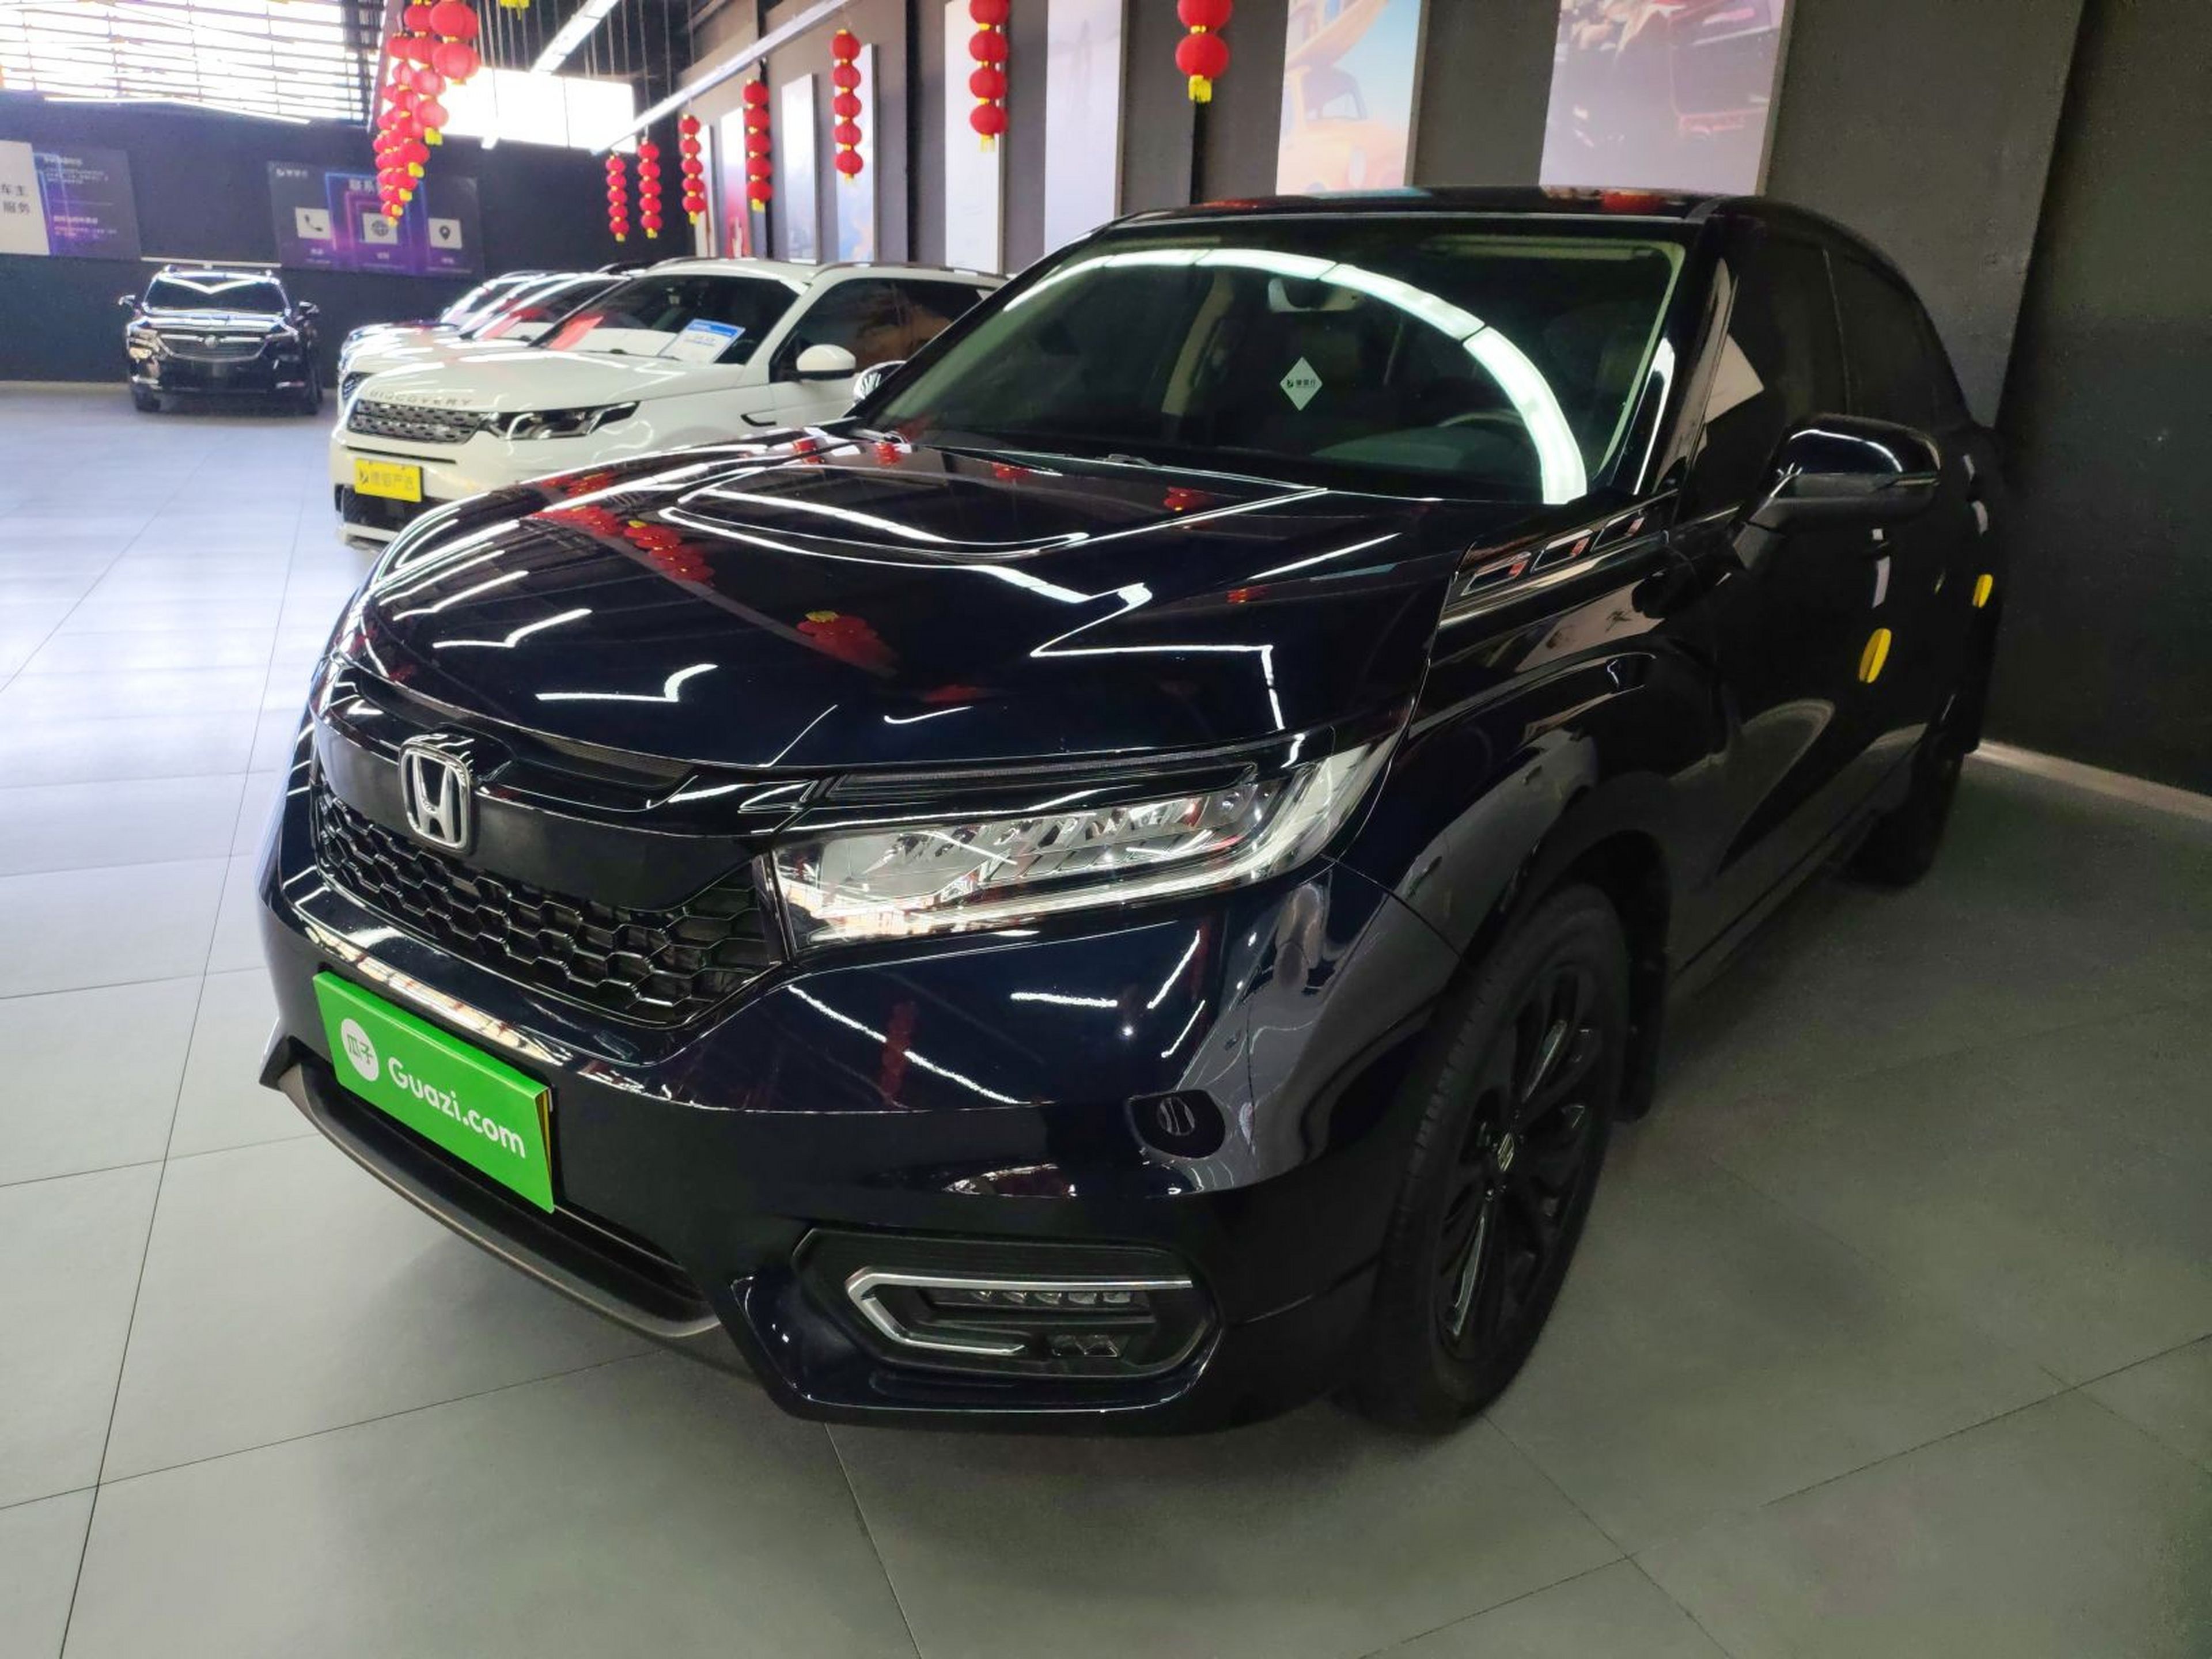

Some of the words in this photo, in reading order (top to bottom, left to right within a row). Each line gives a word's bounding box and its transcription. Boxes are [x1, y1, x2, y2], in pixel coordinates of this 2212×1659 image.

[3, 202, 31, 214] 服务
[347, 1033, 374, 1066] 瓜子
[388, 1056, 527, 1159] Guazi.com
